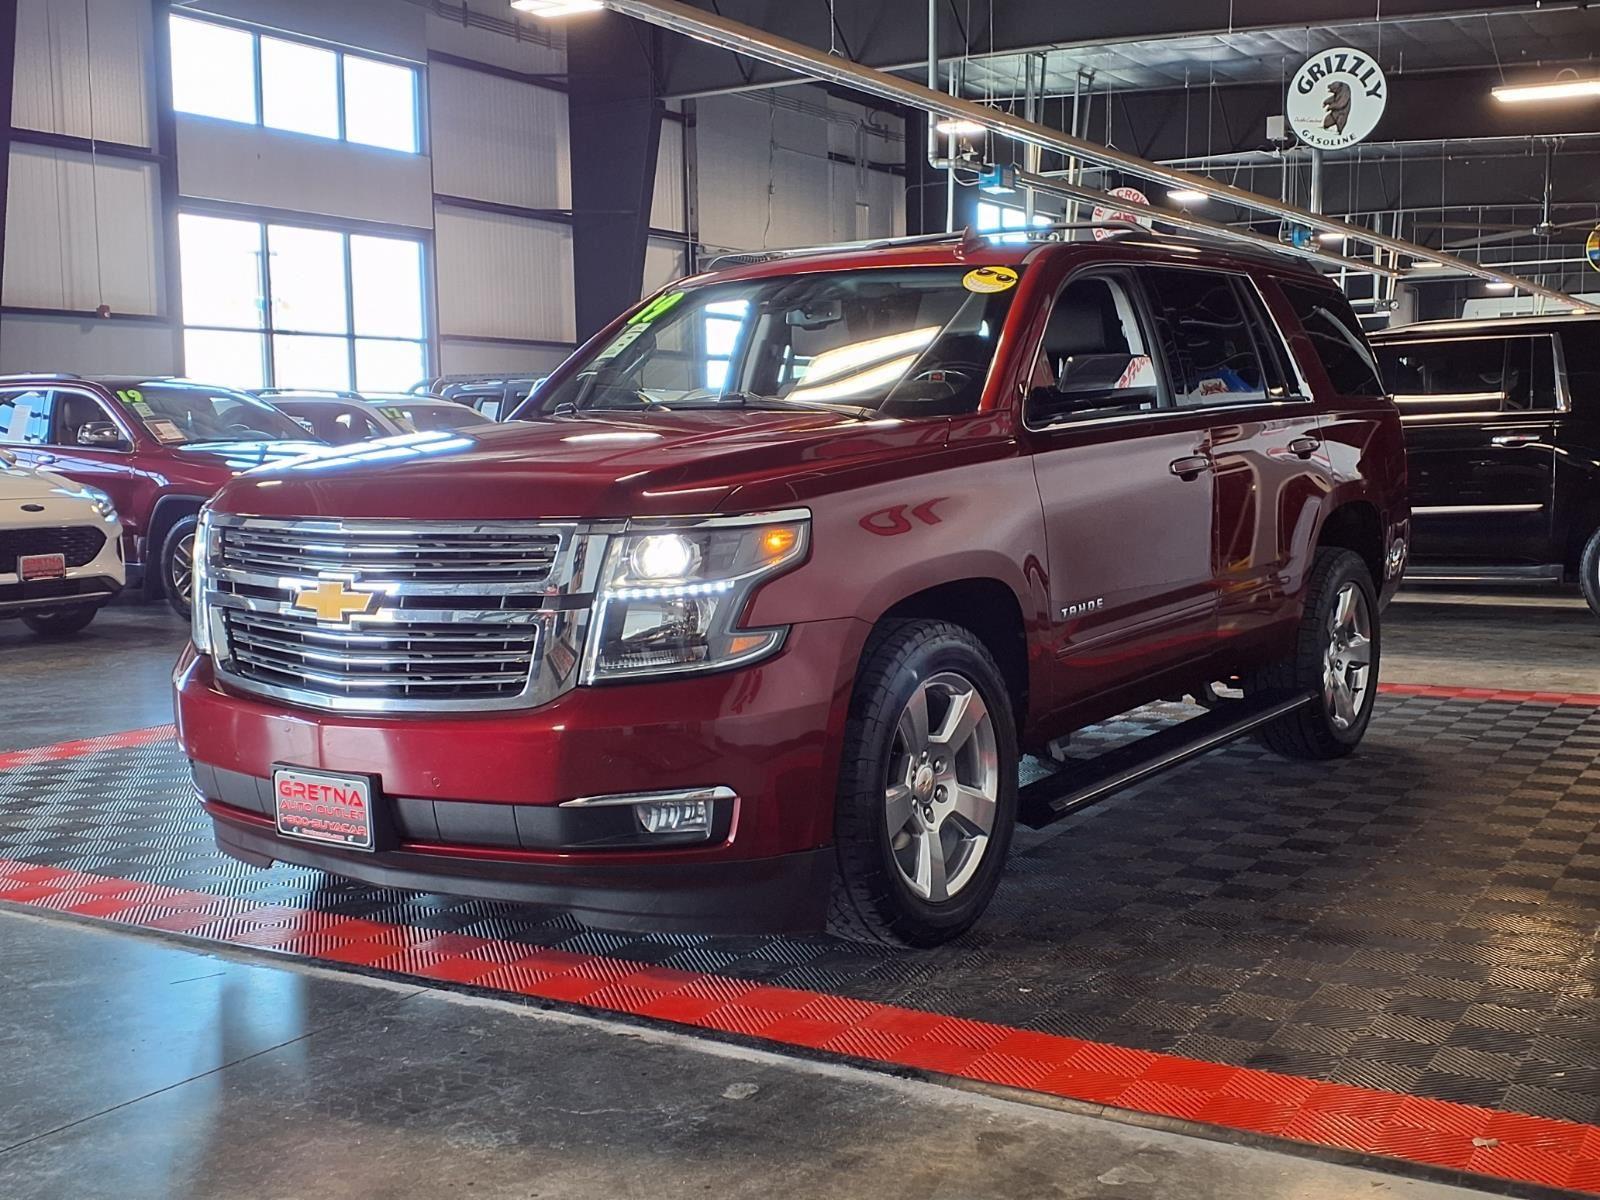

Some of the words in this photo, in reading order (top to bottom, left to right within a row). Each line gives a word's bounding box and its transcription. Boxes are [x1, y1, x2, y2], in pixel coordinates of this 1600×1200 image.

[1297, 53, 1383, 99] GRIZZLY
[1302, 129, 1357, 146] GASOLINE
[116, 389, 144, 403] 19
[1061, 598, 1104, 618] TAHOE
[279, 780, 364, 808] GRETNA
[280, 799, 313, 815] AUTO
[315, 804, 365, 821] OUTLET
